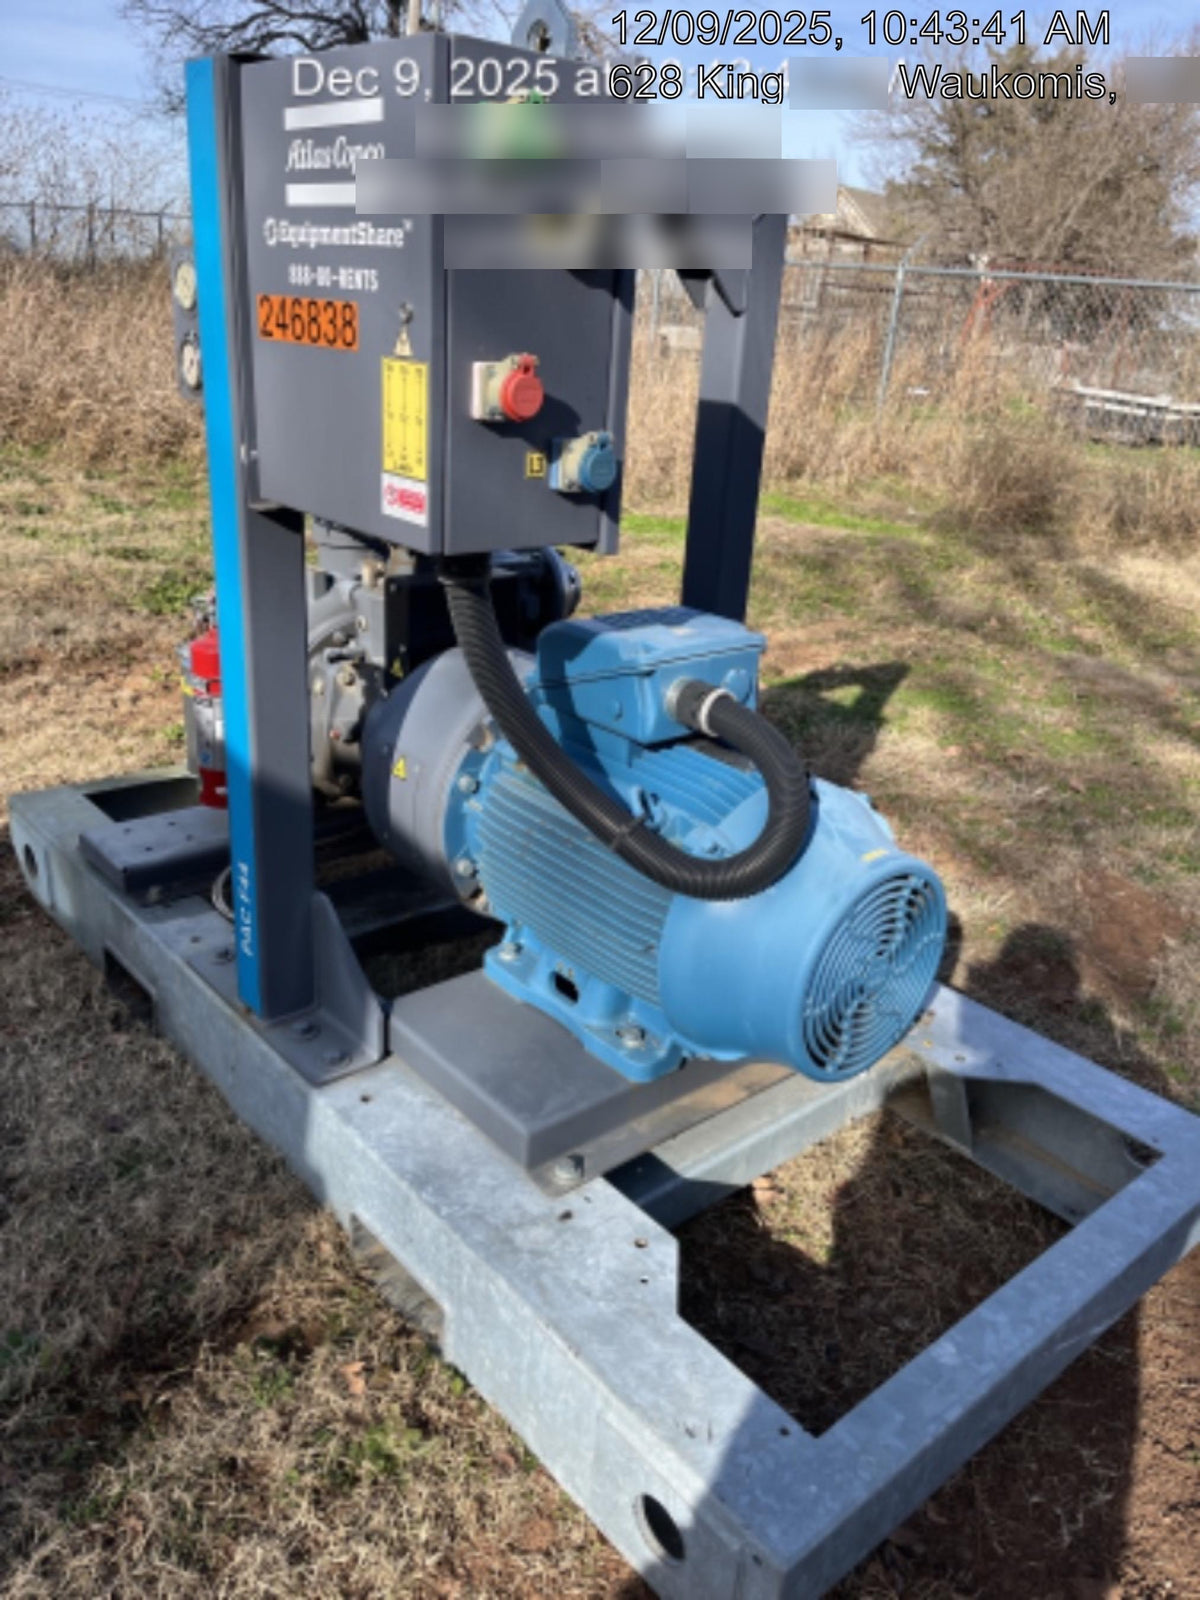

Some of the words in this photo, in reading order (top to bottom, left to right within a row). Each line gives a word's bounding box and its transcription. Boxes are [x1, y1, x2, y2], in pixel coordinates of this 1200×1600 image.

[285, 138, 332, 172] Atlas
[278, 220, 405, 248] EquipmentShare
[260, 294, 357, 348] 246838
